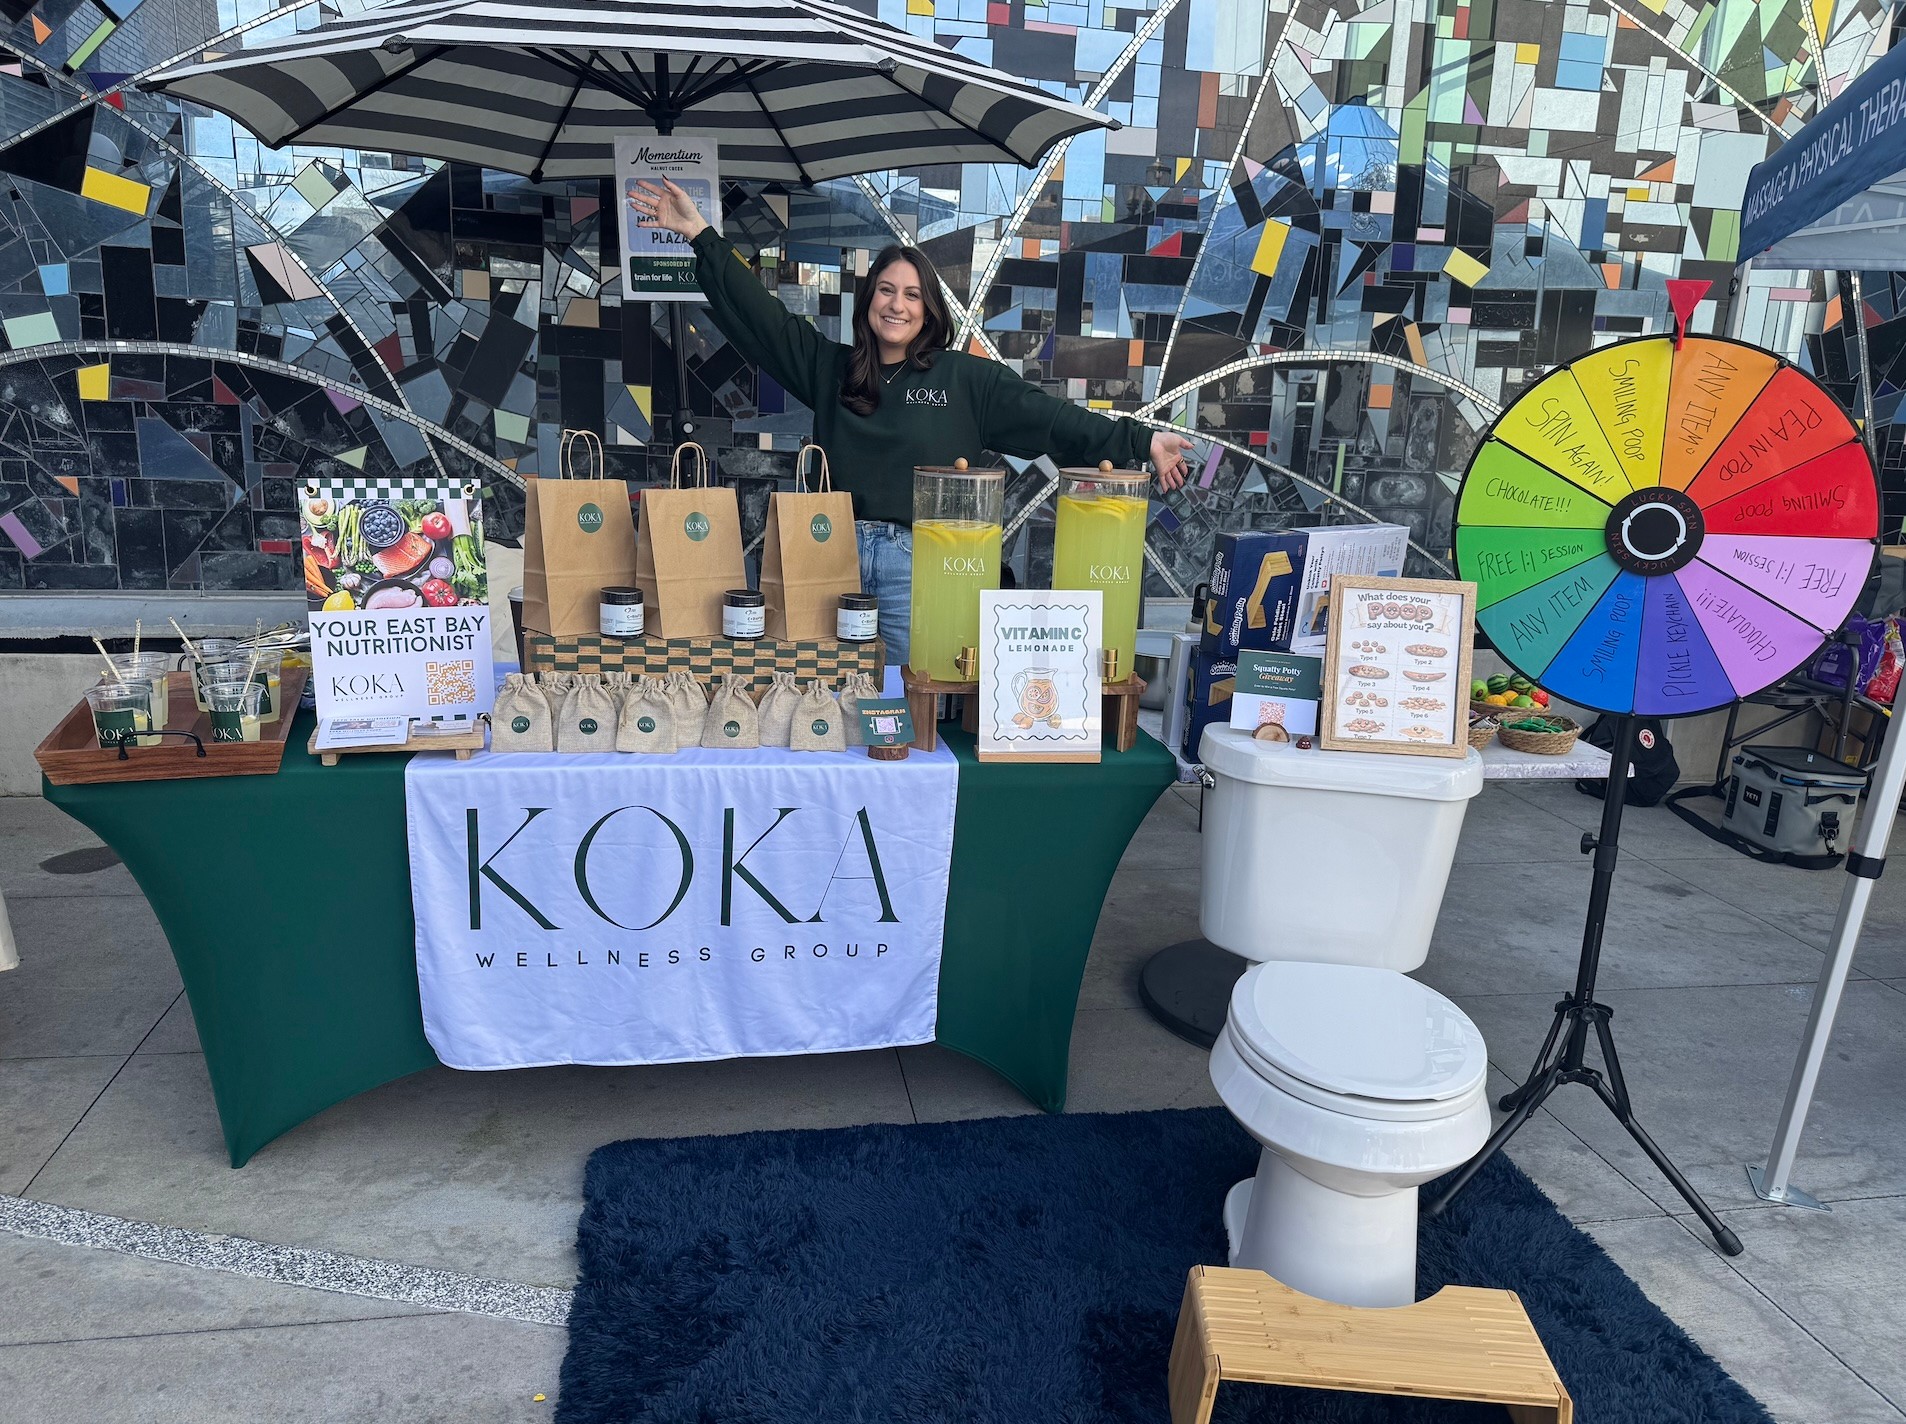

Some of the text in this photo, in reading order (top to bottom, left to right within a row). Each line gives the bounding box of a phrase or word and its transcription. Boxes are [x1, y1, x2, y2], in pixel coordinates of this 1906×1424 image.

[630, 146, 704, 165] Momentum
[1743, 165, 1788, 229] MASSAGE
[1796, 111, 1854, 190] PHYSICAL
[634, 273, 673, 281] train for life
[1694, 351, 1738, 400] ANY
[906, 388, 948, 403] KOKA
[1609, 359, 1645, 461] SMILING POOP
[1526, 398, 1614, 487] SPIN AGAIN!
[1720, 399, 1823, 481] PEA IN POD
[1485, 478, 1572, 513] CHOCOLATE!!!
[1782, 484, 1845, 511] SMILING
[580, 513, 601, 522] KOKA
[1630, 493, 1697, 530] LUCKY SPIN
[686, 521, 708, 530] KOKA
[812, 523, 831, 531] KOKA
[1477, 550, 1518, 582] FREE
[1540, 544, 1584, 564] SESSION
[1611, 532, 1676, 570] SPIN LUCKY
[1733, 548, 1775, 573] SESSION
[943, 557, 985, 572] KOKA
[1090, 565, 1130, 580] KOKA
[1799, 563, 1846, 598] FREE
[1357, 592, 1431, 605] What does your
[1510, 576, 1594, 651] ANY ITEM
[1696, 588, 1777, 662] CHOCOLATE!!!
[311, 615, 486, 638] YOUR EAST BAY
[1000, 627, 1082, 640] VITAMIN C
[1367, 620, 1434, 633] say about you?
[1582, 593, 1632, 683] SMILING POOP
[327, 634, 475, 657] NUTRITIONIST
[1009, 644, 1075, 652] LEMONADE
[1661, 593, 1698, 698] PICKLE KEYCHAIN
[1253, 664, 1302, 676] Squatty Potty
[1259, 672, 1294, 683] Giveaway
[332, 673, 404, 696] KOKA
[1746, 791, 1758, 801] YETI
[466, 805, 902, 931] KOKA
[475, 942, 888, 968] WELLNESS GROUP
